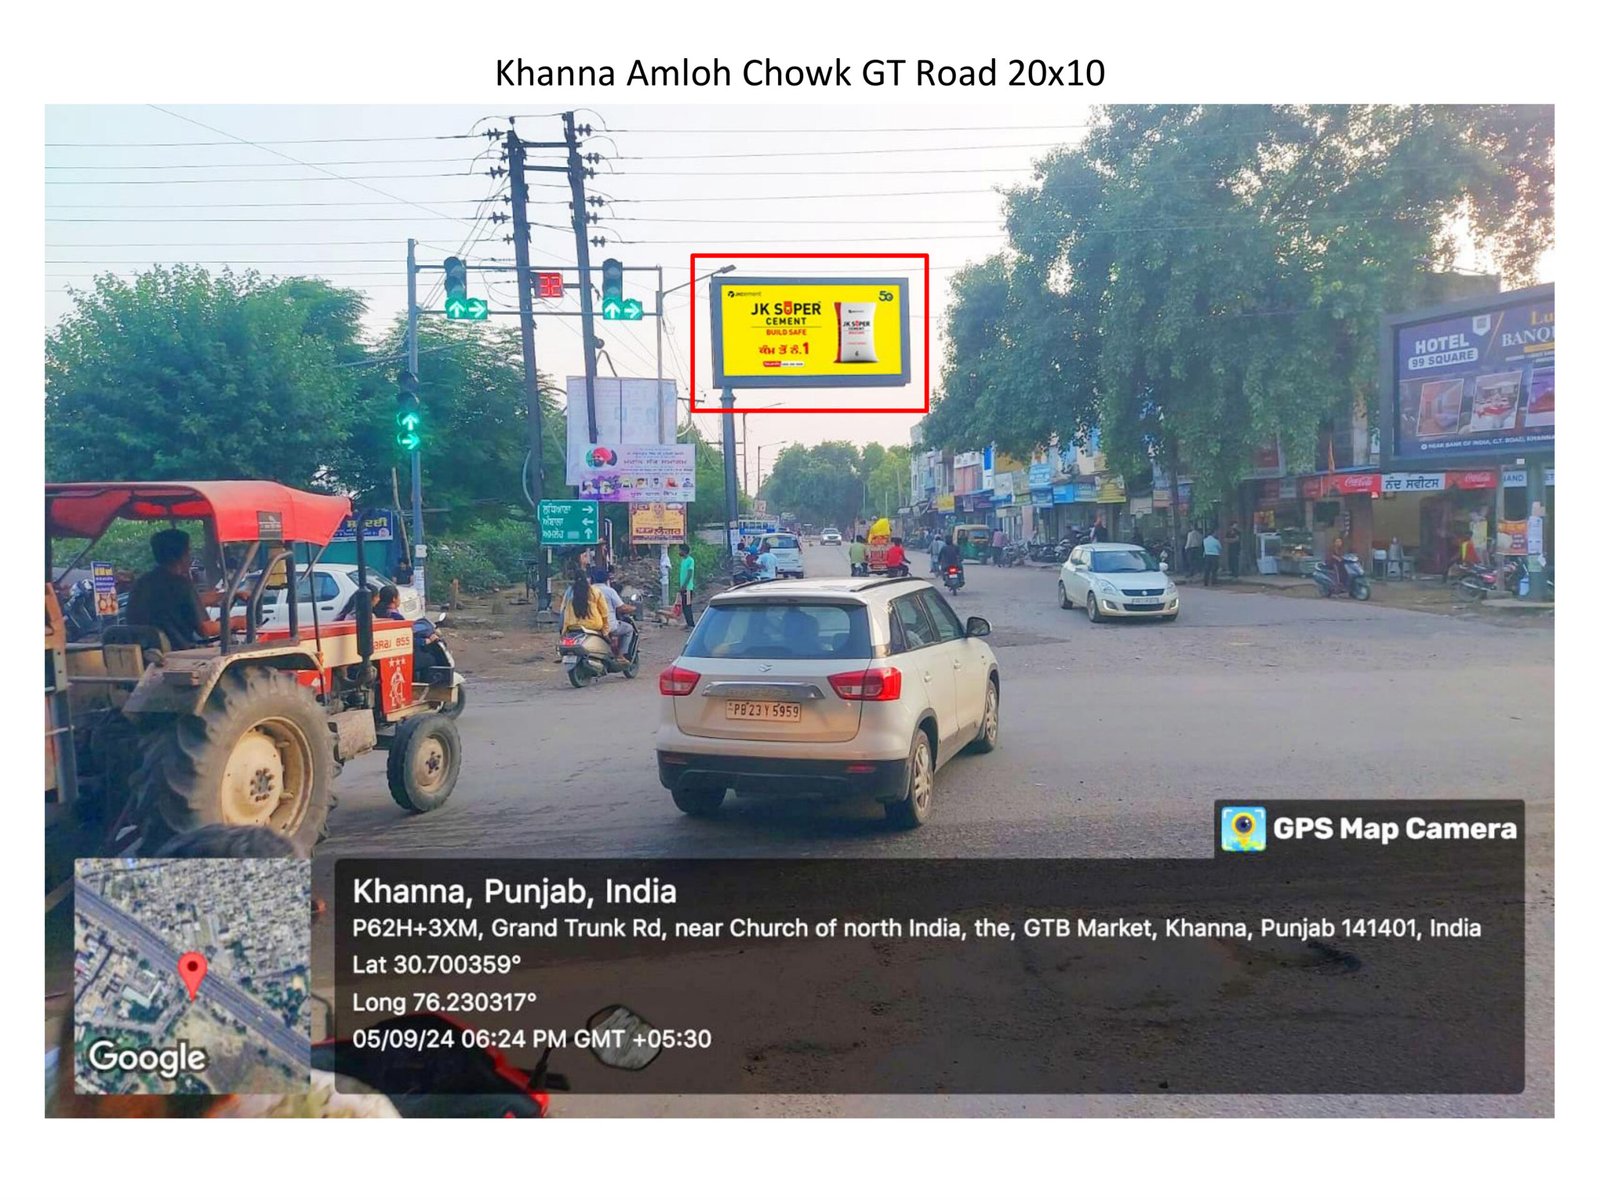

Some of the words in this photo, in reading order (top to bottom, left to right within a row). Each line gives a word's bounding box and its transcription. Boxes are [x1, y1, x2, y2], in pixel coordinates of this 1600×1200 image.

[540, 276, 562, 297] 32
[751, 303, 770, 315] JK
[774, 301, 821, 315] SUPER
[766, 317, 807, 325] CEMENT
[766, 328, 788, 336] BUILD
[789, 328, 807, 336] SAFE
[1415, 333, 1470, 354] HOTEL
[1411, 357, 1426, 368] 99
[1428, 350, 1475, 365] SQUARE
[1385, 476, 1401, 490] ਨੰਦ
[1406, 476, 1440, 489] ਸਵੀਟਸ
[734, 703, 747, 716] PB
[749, 704, 761, 717] 23
[764, 705, 770, 717] Y
[773, 704, 799, 718] 5959
